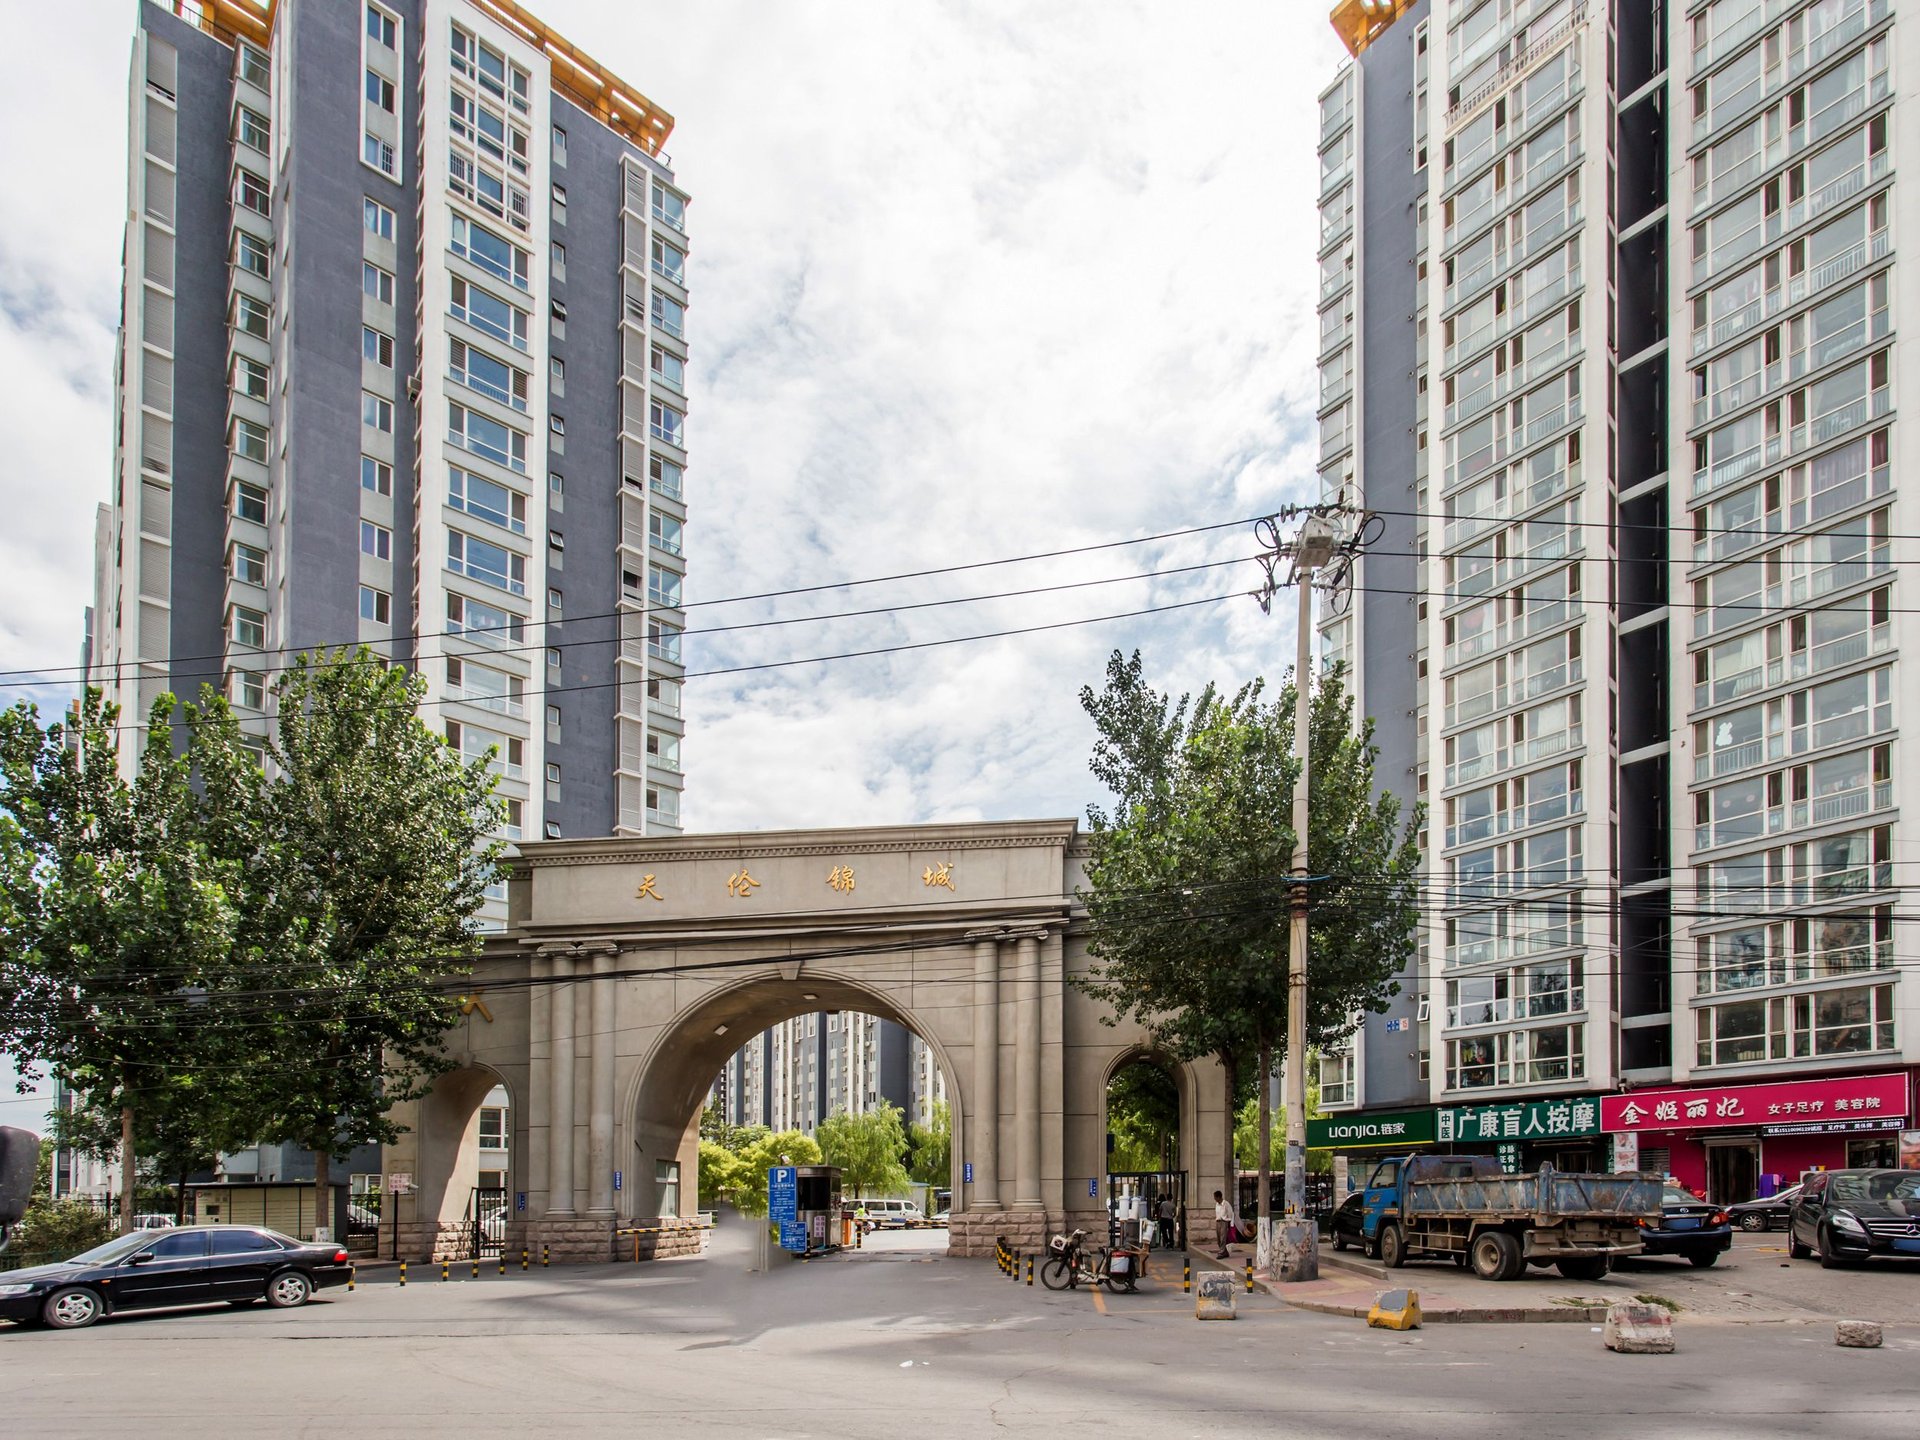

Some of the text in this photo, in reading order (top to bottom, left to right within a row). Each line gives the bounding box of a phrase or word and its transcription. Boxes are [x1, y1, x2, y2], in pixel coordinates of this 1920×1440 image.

[636, 862, 956, 902] 天伦锦城
[1456, 1101, 1595, 1139] 广康盲人按摩
[1618, 1096, 1881, 1125] 金姬丽妃 女子足疗 美容院
[1441, 1113, 1451, 1139] 中医
[777, 1169, 788, 1183] P
